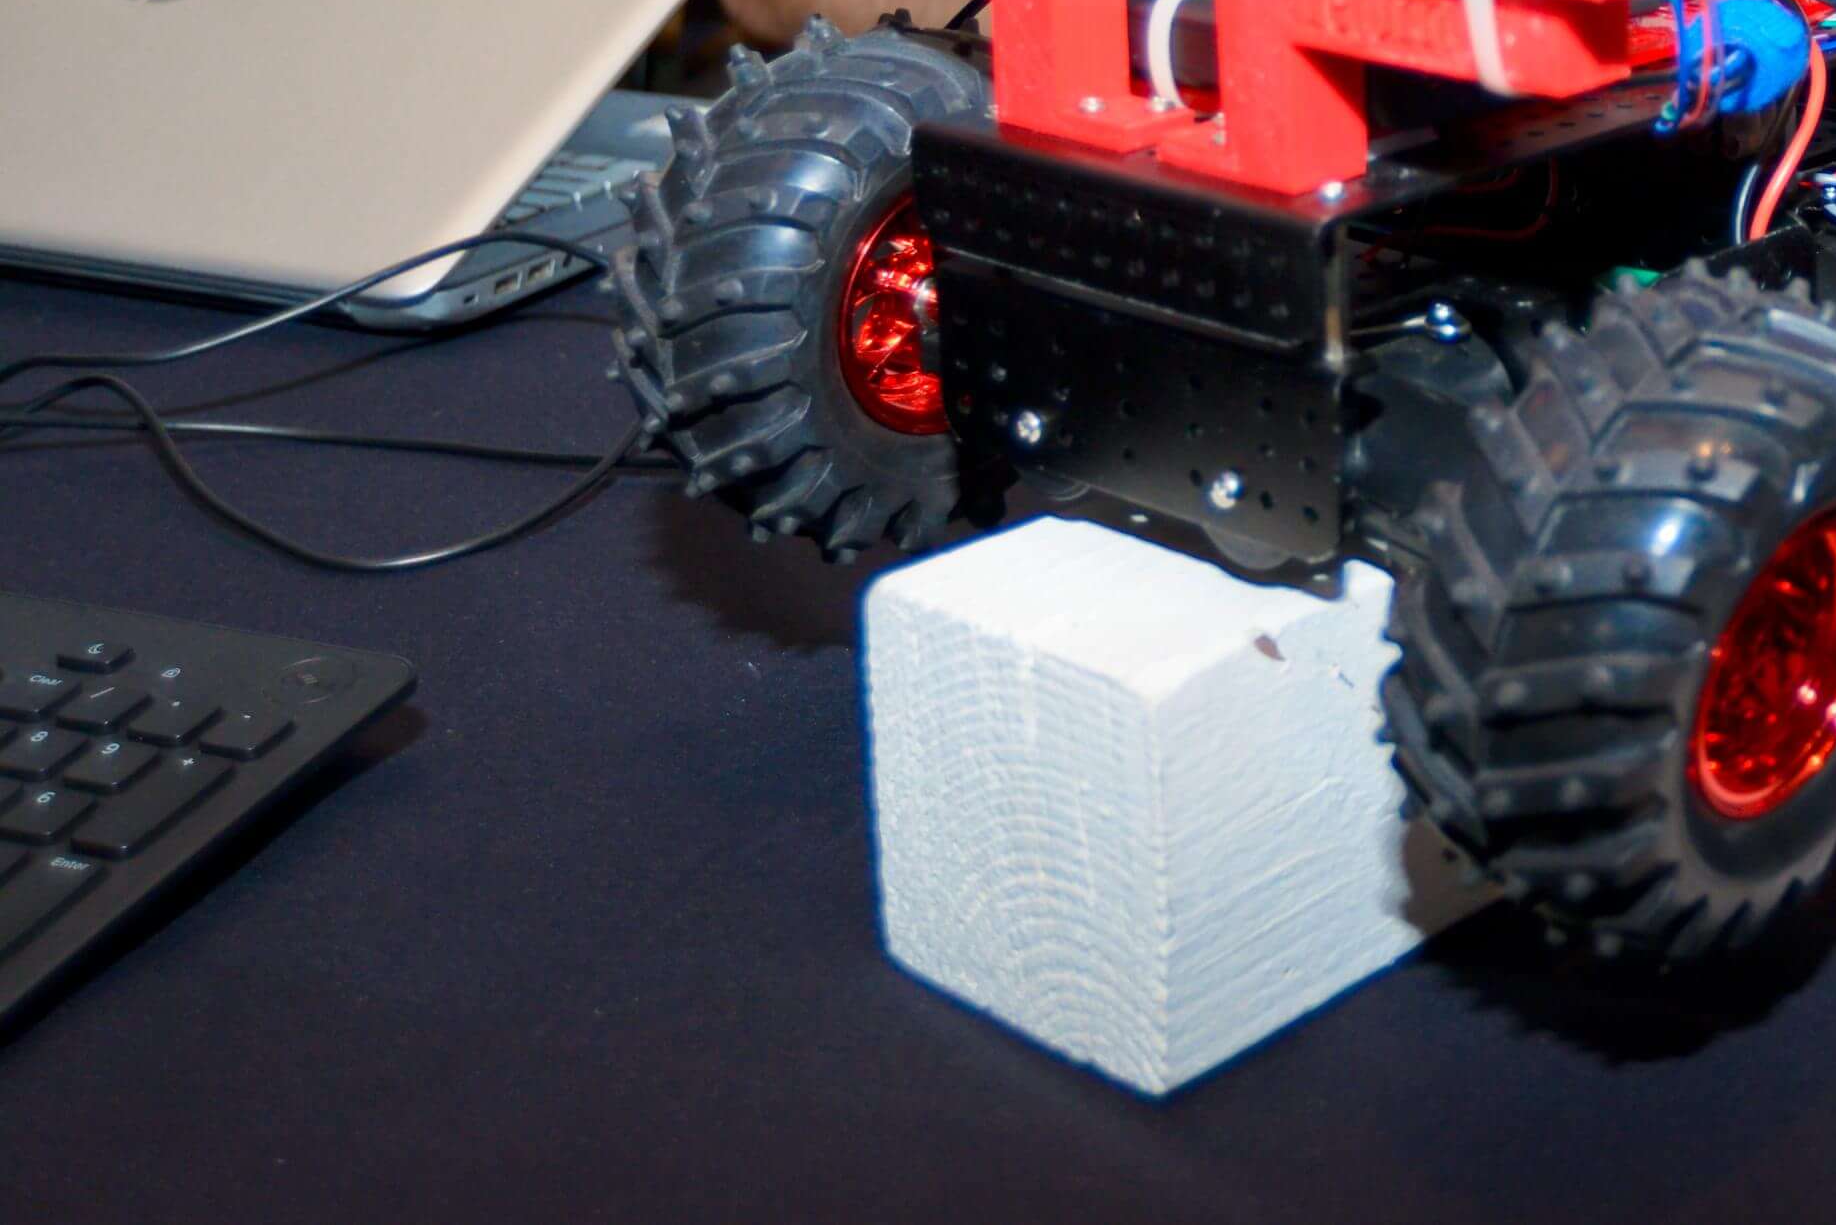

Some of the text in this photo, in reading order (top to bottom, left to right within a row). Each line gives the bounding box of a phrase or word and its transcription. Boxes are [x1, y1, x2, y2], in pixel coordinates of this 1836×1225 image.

[31, 730, 49, 743] 8
[102, 742, 120, 755] 9
[37, 791, 56, 804] 6
[51, 856, 91, 871] Enter
